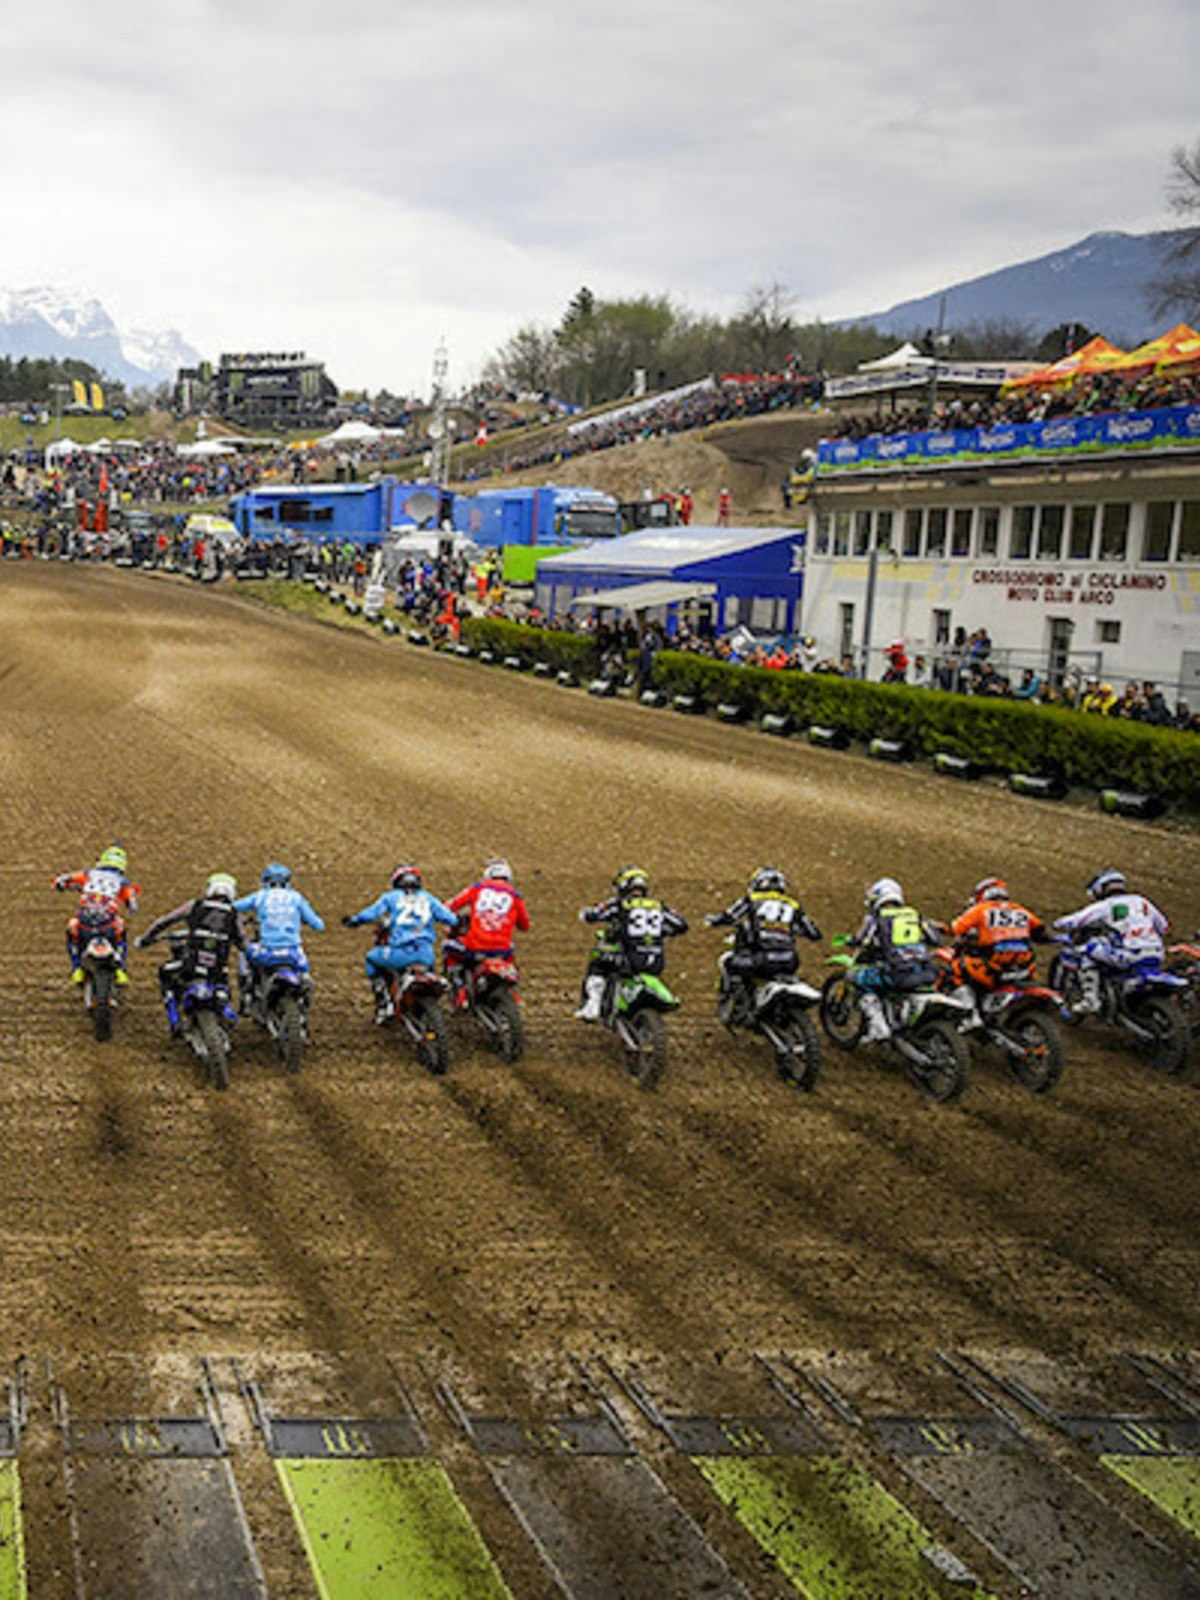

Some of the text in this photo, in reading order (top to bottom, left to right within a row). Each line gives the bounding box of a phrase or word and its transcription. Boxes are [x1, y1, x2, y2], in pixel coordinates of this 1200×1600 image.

[1089, 573, 1167, 590] CICLAMINO
[1008, 588, 1115, 605] MOTO CLUB ARCO
[627, 908, 663, 937] 33
[988, 909, 1029, 929] 152
